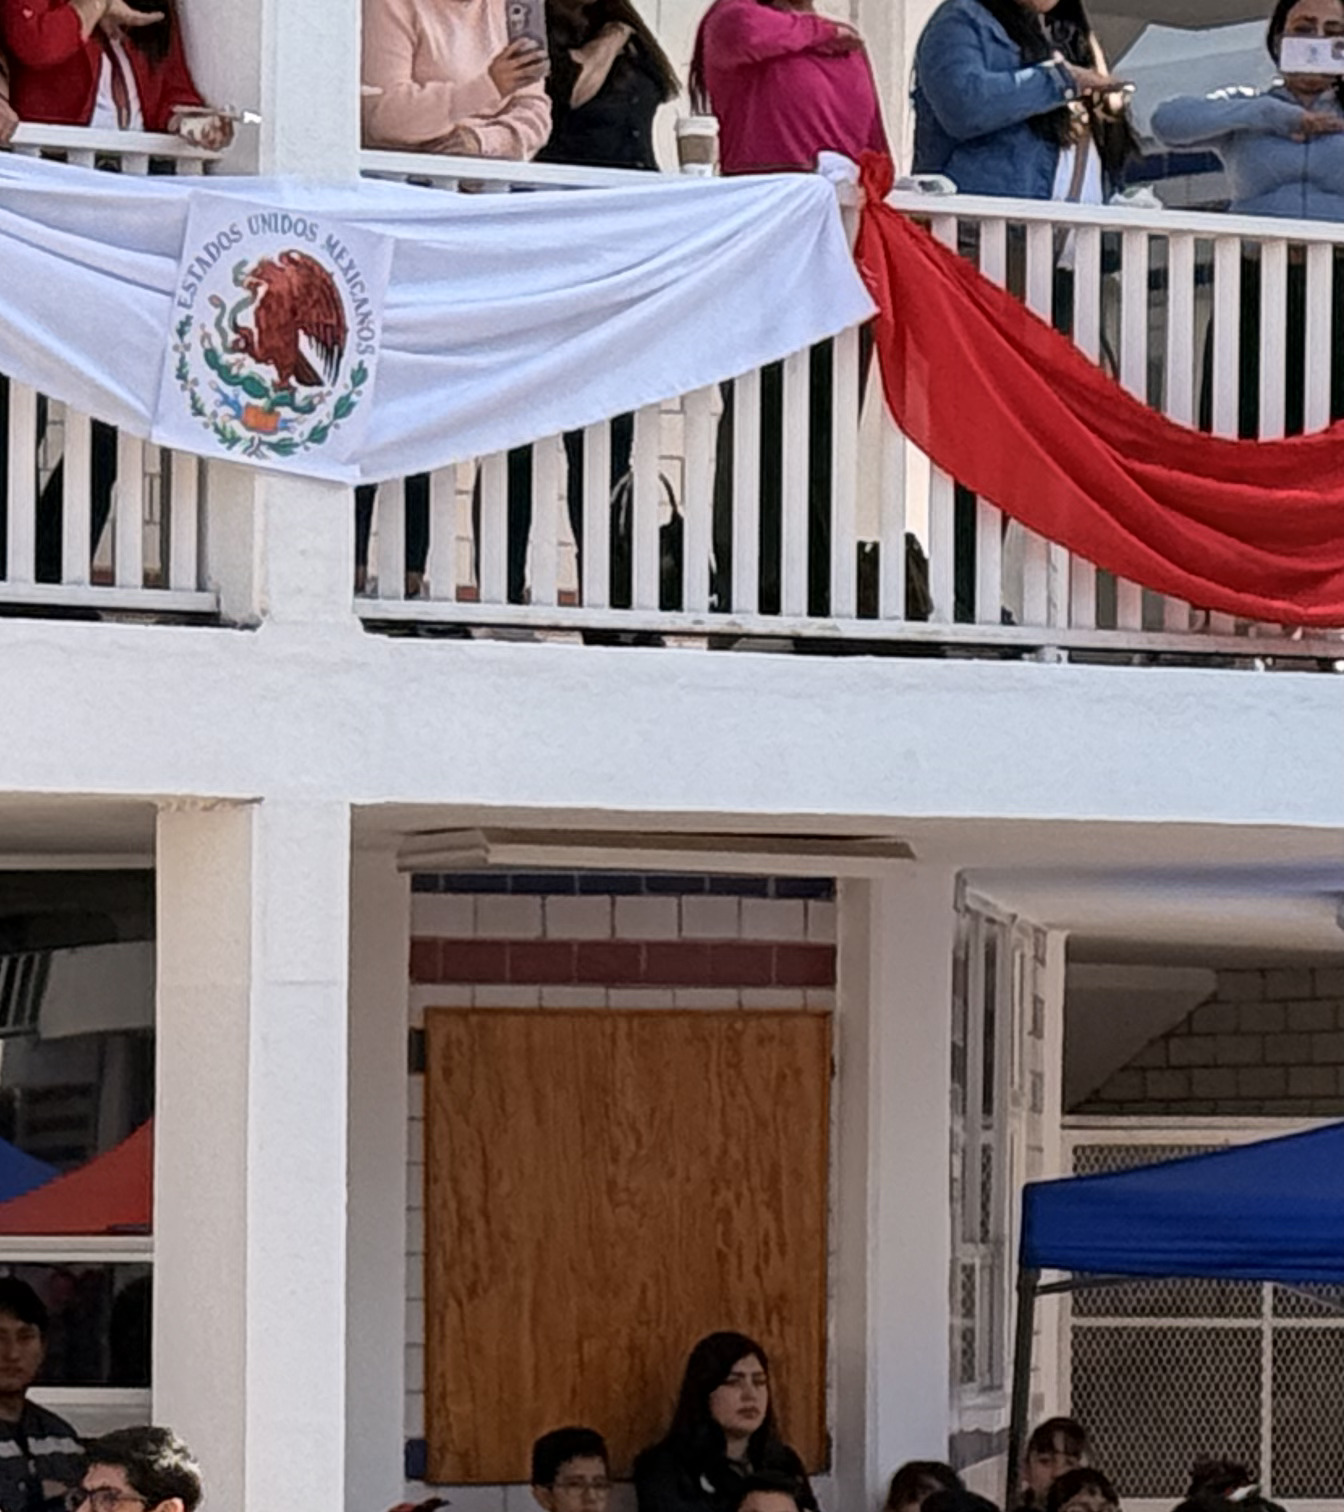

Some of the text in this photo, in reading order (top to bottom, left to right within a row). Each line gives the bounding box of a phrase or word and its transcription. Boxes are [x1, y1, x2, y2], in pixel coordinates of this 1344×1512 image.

[176, 211, 376, 356] ESTADOS UNIDOS MEXICANOS
